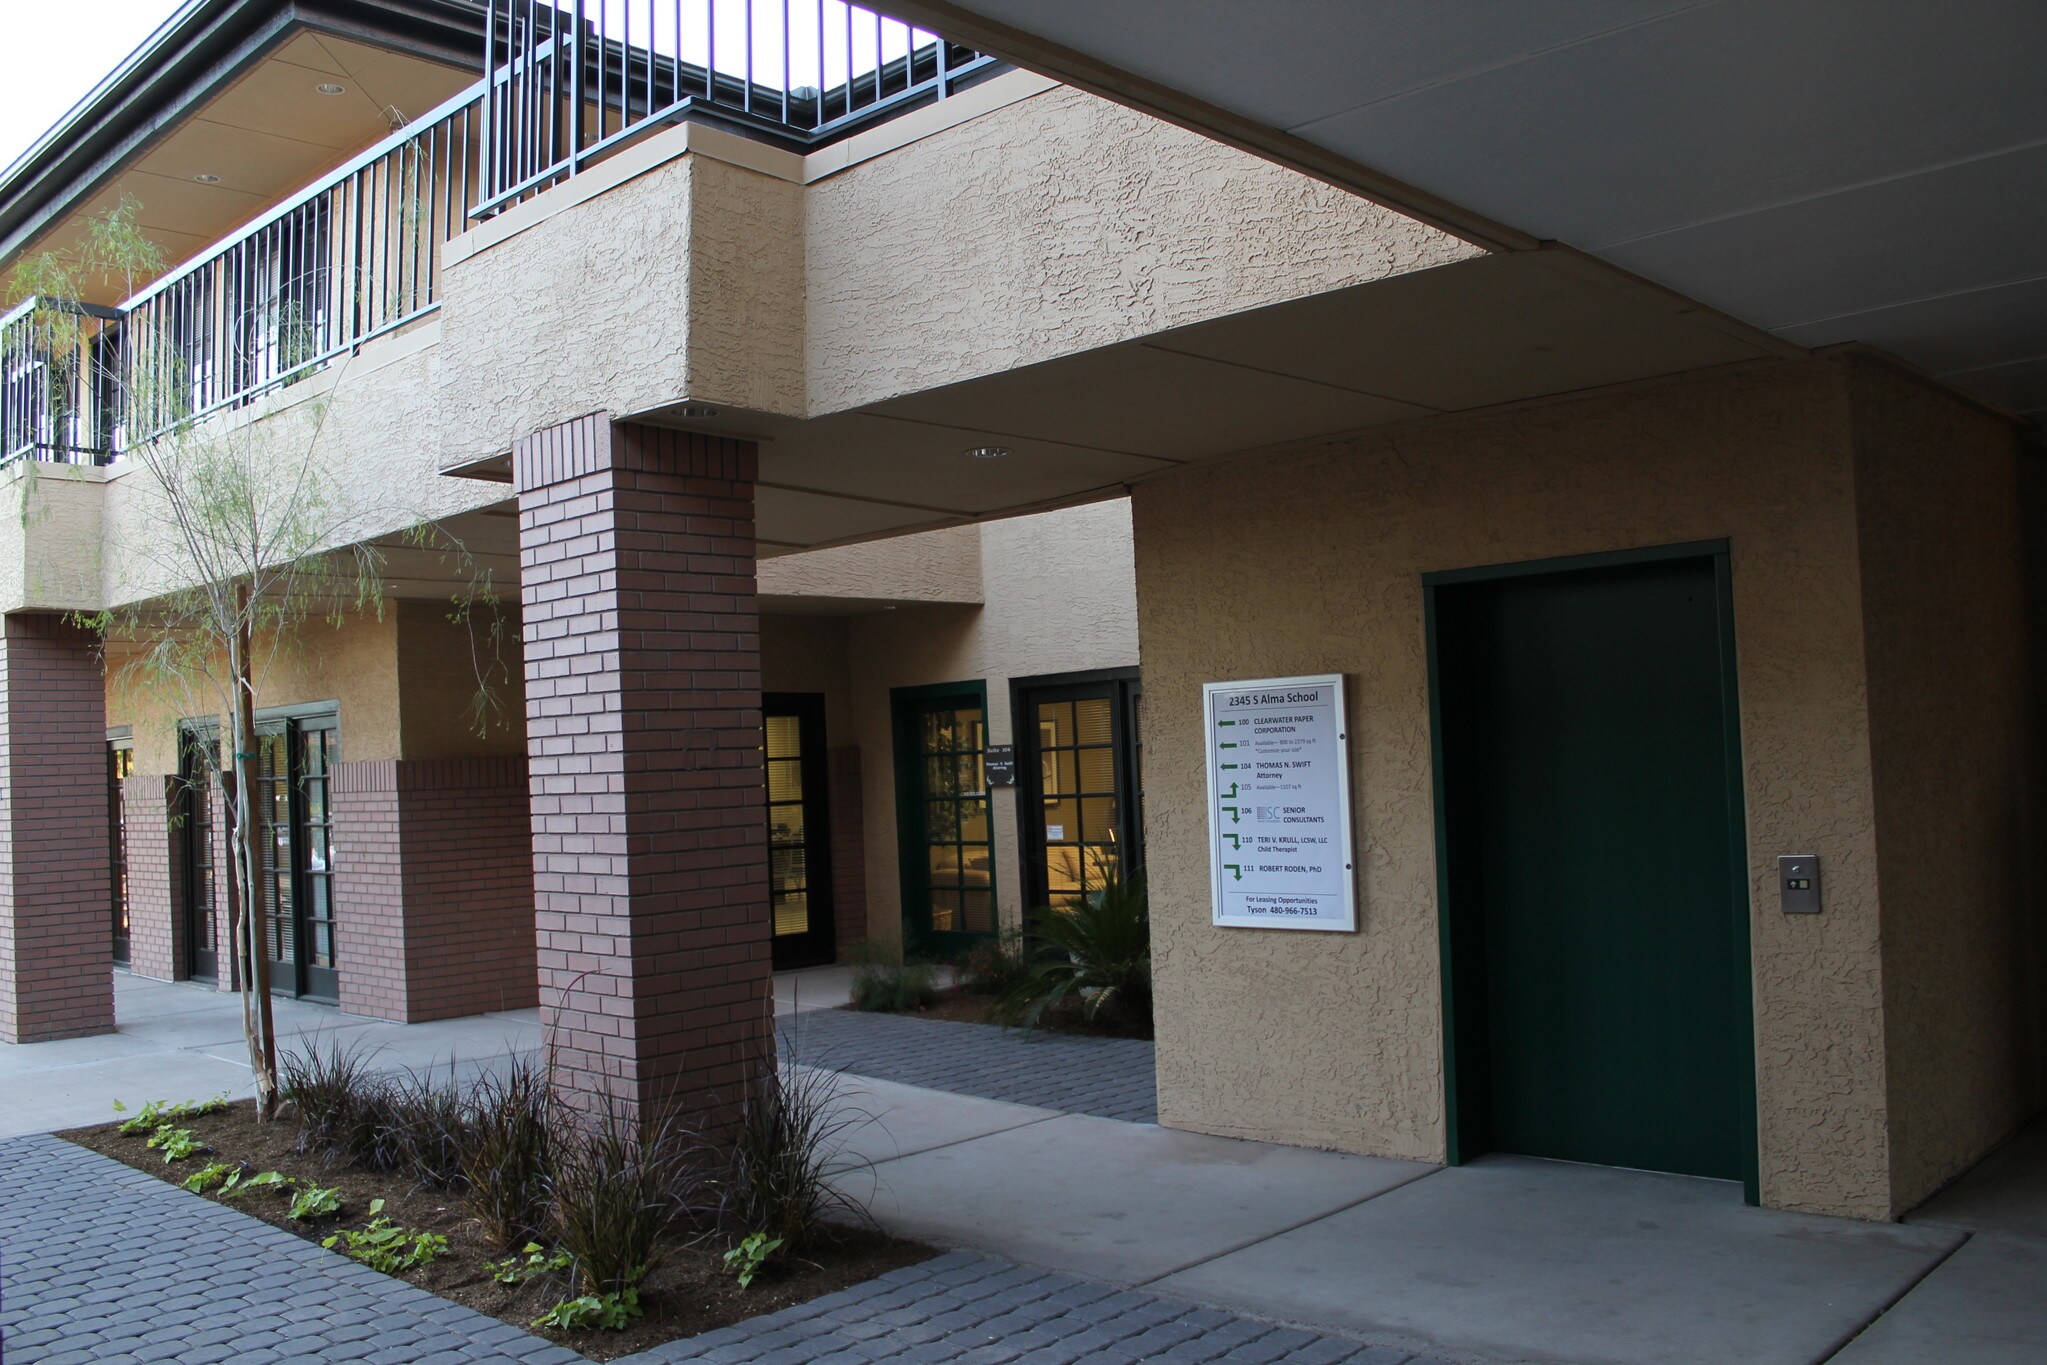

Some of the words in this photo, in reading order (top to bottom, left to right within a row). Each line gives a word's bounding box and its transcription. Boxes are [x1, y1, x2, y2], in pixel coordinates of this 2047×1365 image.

[1229, 695, 1251, 707] 2345
[1253, 695, 1259, 705] S
[1261, 693, 1284, 704] Alma
[1287, 691, 1318, 703] School
[1254, 716, 1293, 725] CLEARWATER
[1294, 715, 1314, 723] PAPER
[1254, 726, 1296, 734] CORPORATION
[1283, 816, 1324, 824] CONSULTANTS
[1279, 837, 1300, 845] KRULL,
[1301, 837, 1318, 845] LCSW,
[1273, 846, 1297, 854] Therapist
[1284, 866, 1308, 874] RODEN,
[1256, 896, 1277, 904] Leasing
[1278, 896, 1318, 905] Opportunities
[1247, 905, 1267, 914] Tyson
[1270, 906, 1317, 916] 480-966-7513
